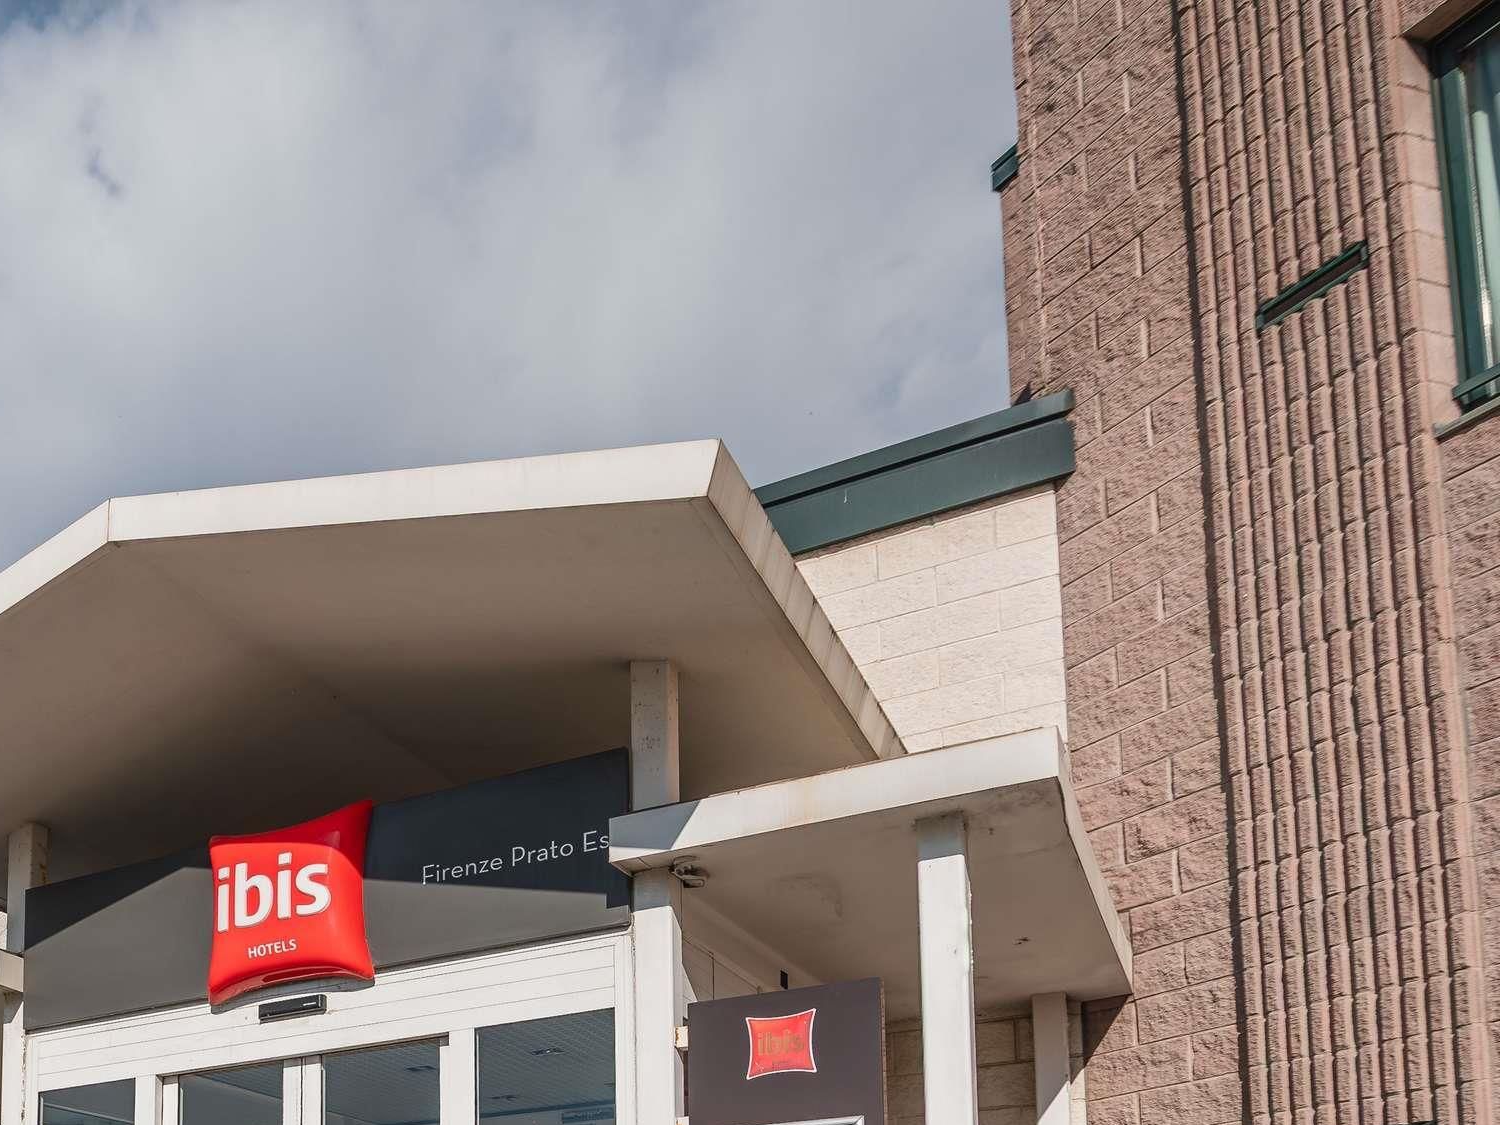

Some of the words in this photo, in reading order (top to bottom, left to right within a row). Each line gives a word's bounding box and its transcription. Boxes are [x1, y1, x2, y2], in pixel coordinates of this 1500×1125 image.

[422, 854, 503, 885] Firenze
[511, 840, 574, 867] Prato
[583, 830, 610, 852] Es
[216, 851, 331, 933] ibis
[247, 938, 298, 959] HOTELS
[757, 1029, 804, 1057] ibis
